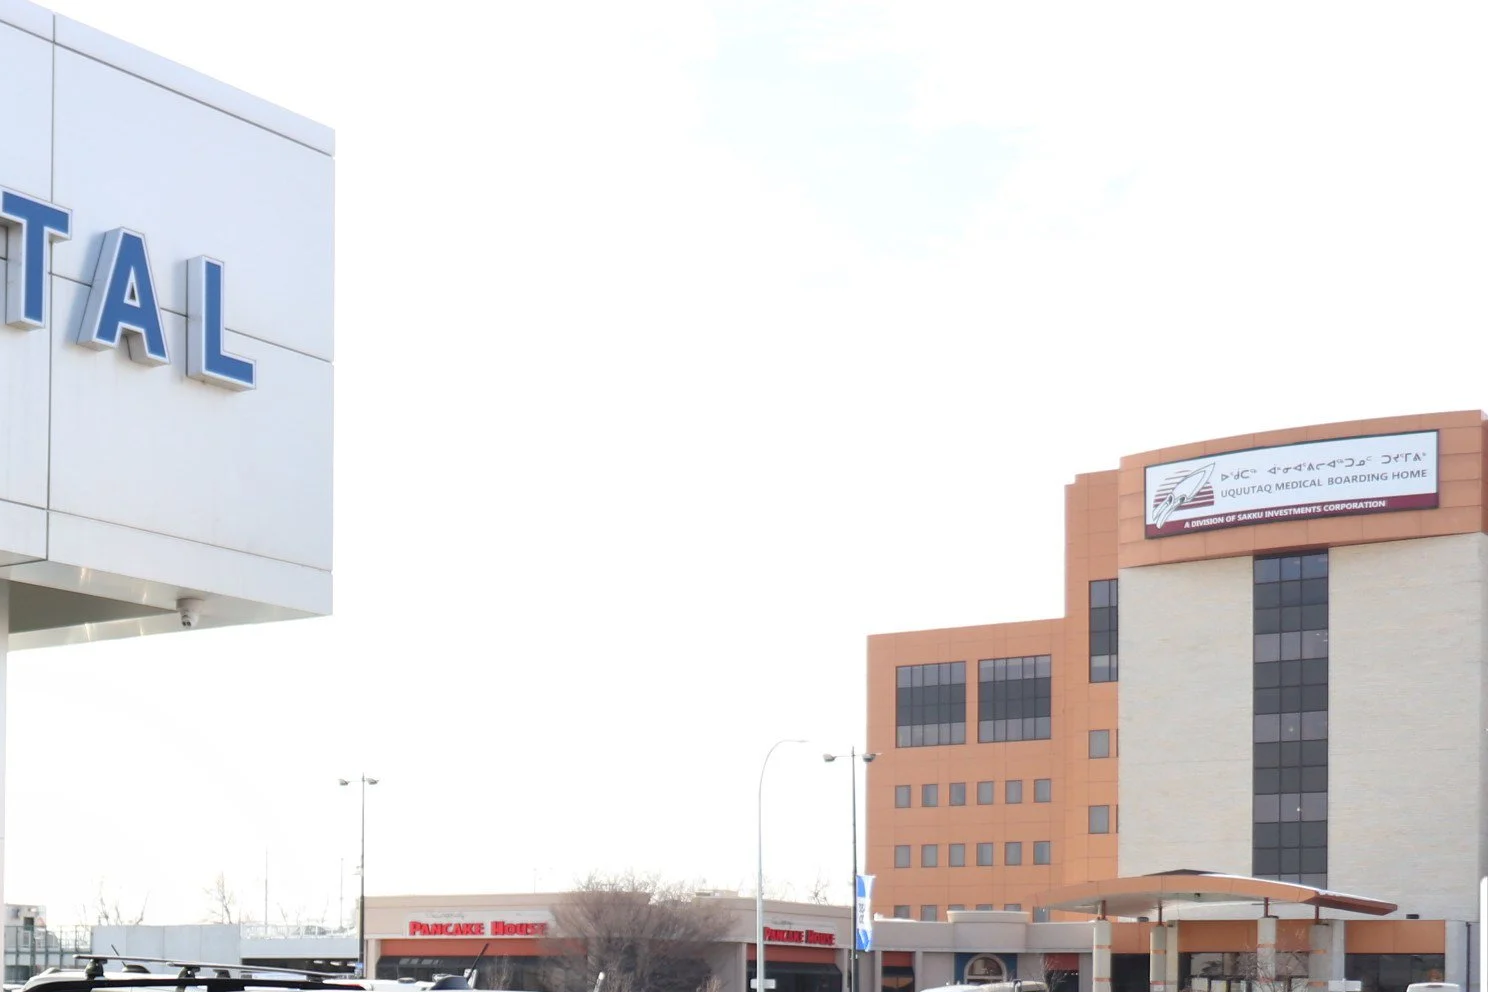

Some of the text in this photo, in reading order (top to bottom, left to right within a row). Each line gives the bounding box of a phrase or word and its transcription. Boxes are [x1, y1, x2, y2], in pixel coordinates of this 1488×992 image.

[1220, 469, 1427, 499] UQUUTAQ MEDICAL BOARDING HOME
[1184, 521, 1190, 529] A
[1191, 516, 1224, 528] DIVISION
[1237, 511, 1263, 521] SAKKU
[1264, 505, 1322, 518] INVESTMENTS
[1323, 500, 1386, 512] CORPORATION
[408, 921, 548, 936] PANCAKE HOUSE
